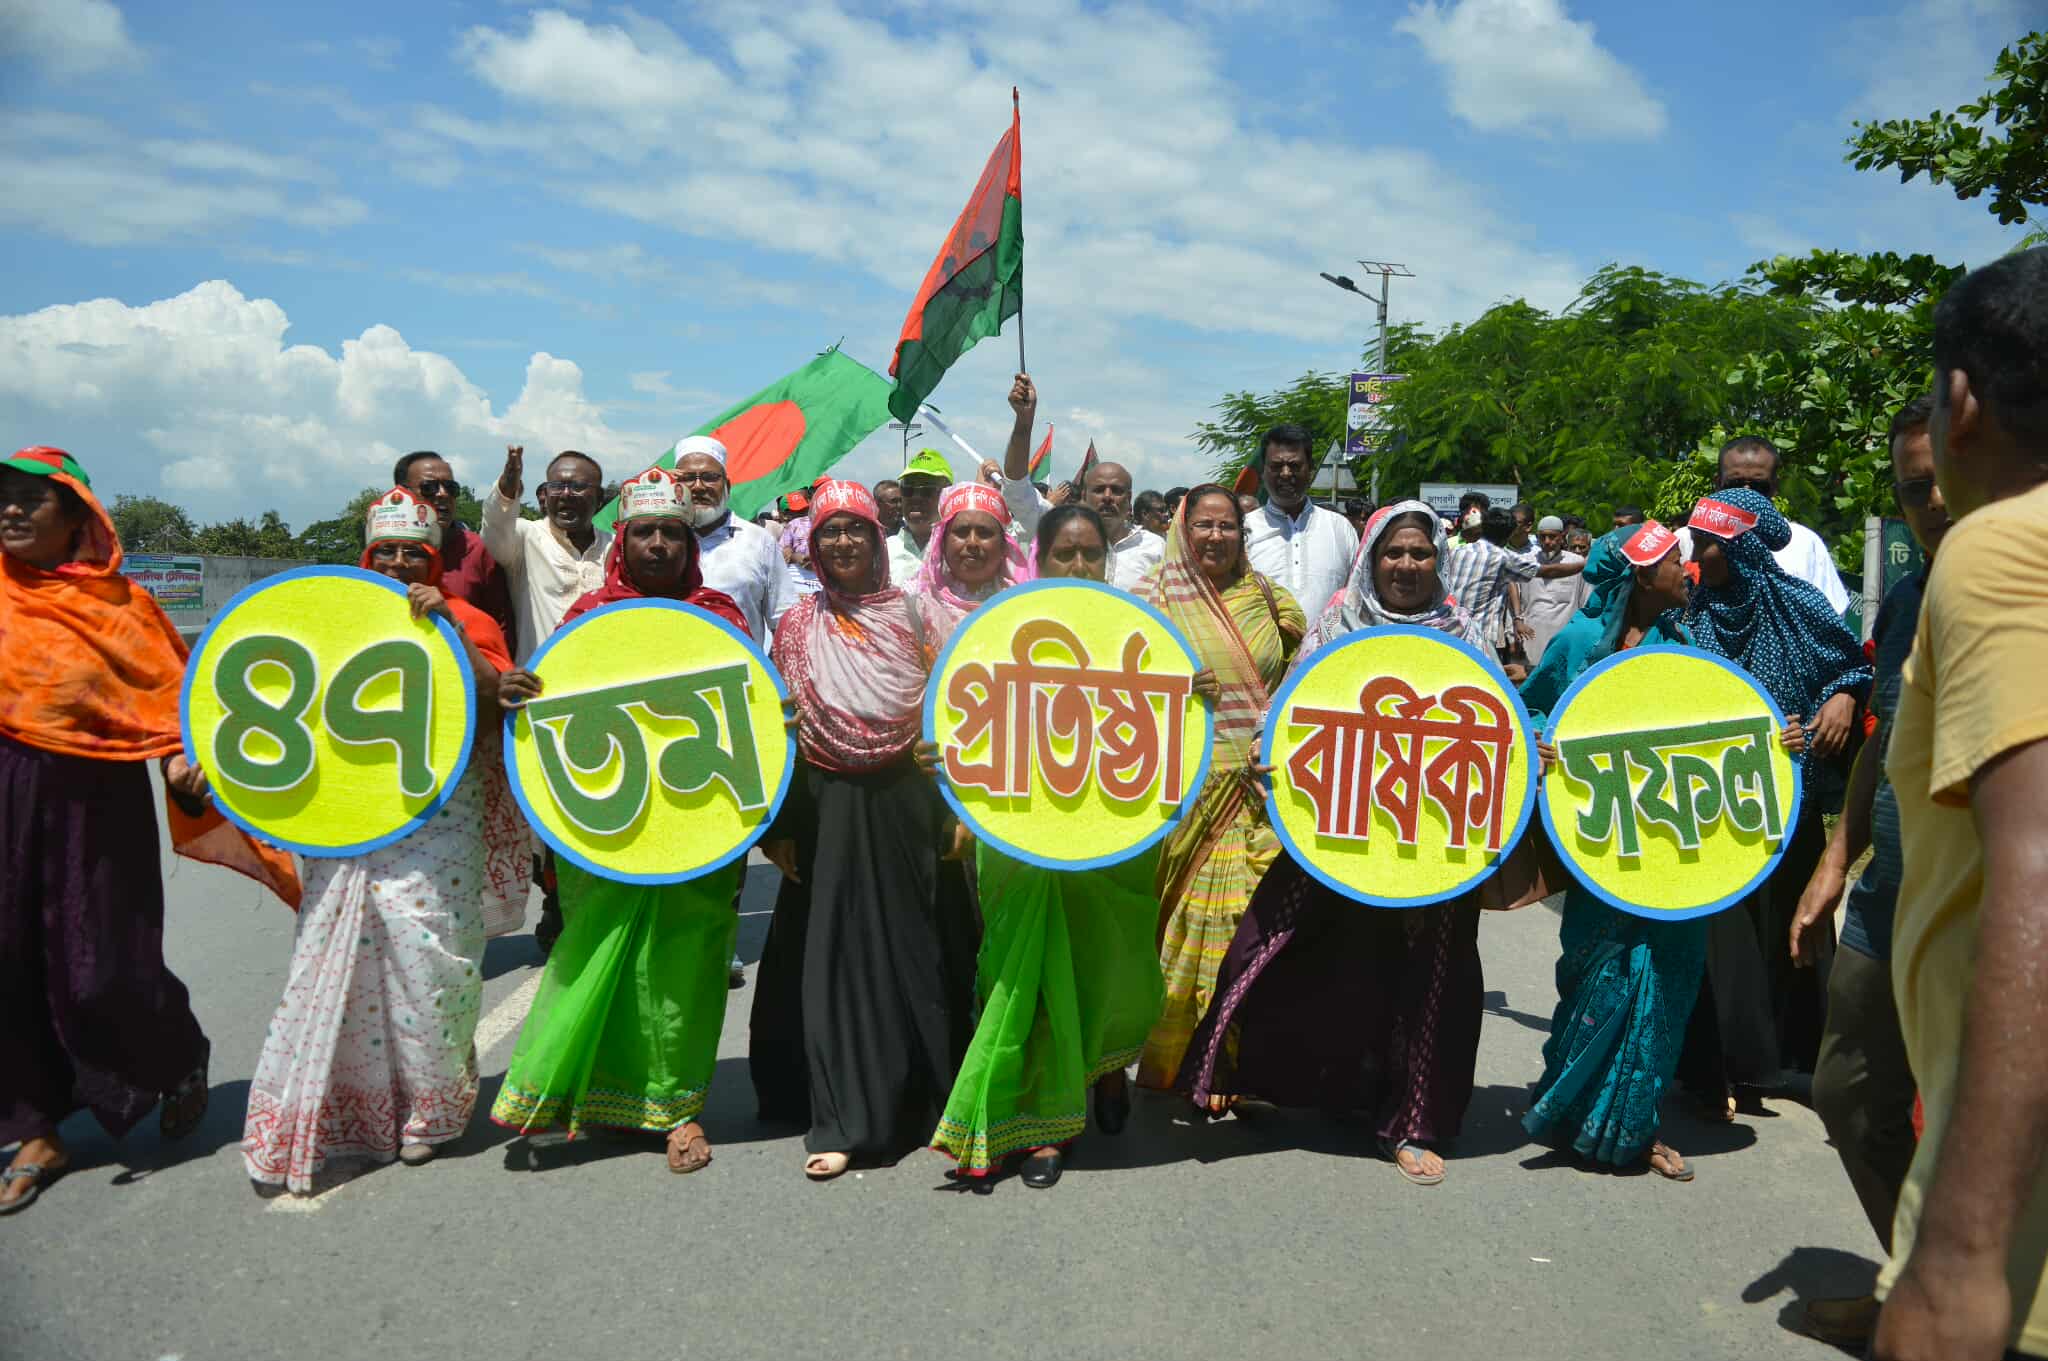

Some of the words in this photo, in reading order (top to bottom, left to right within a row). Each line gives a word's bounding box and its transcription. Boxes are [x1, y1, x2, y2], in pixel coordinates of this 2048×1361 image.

[212, 634, 437, 798] ৪৭
[526, 661, 767, 834] তম
[944, 618, 1191, 804] প্রতিষ্ঠা
[1287, 675, 1514, 853] বার্ষিকী
[1557, 715, 1784, 857] সফল
